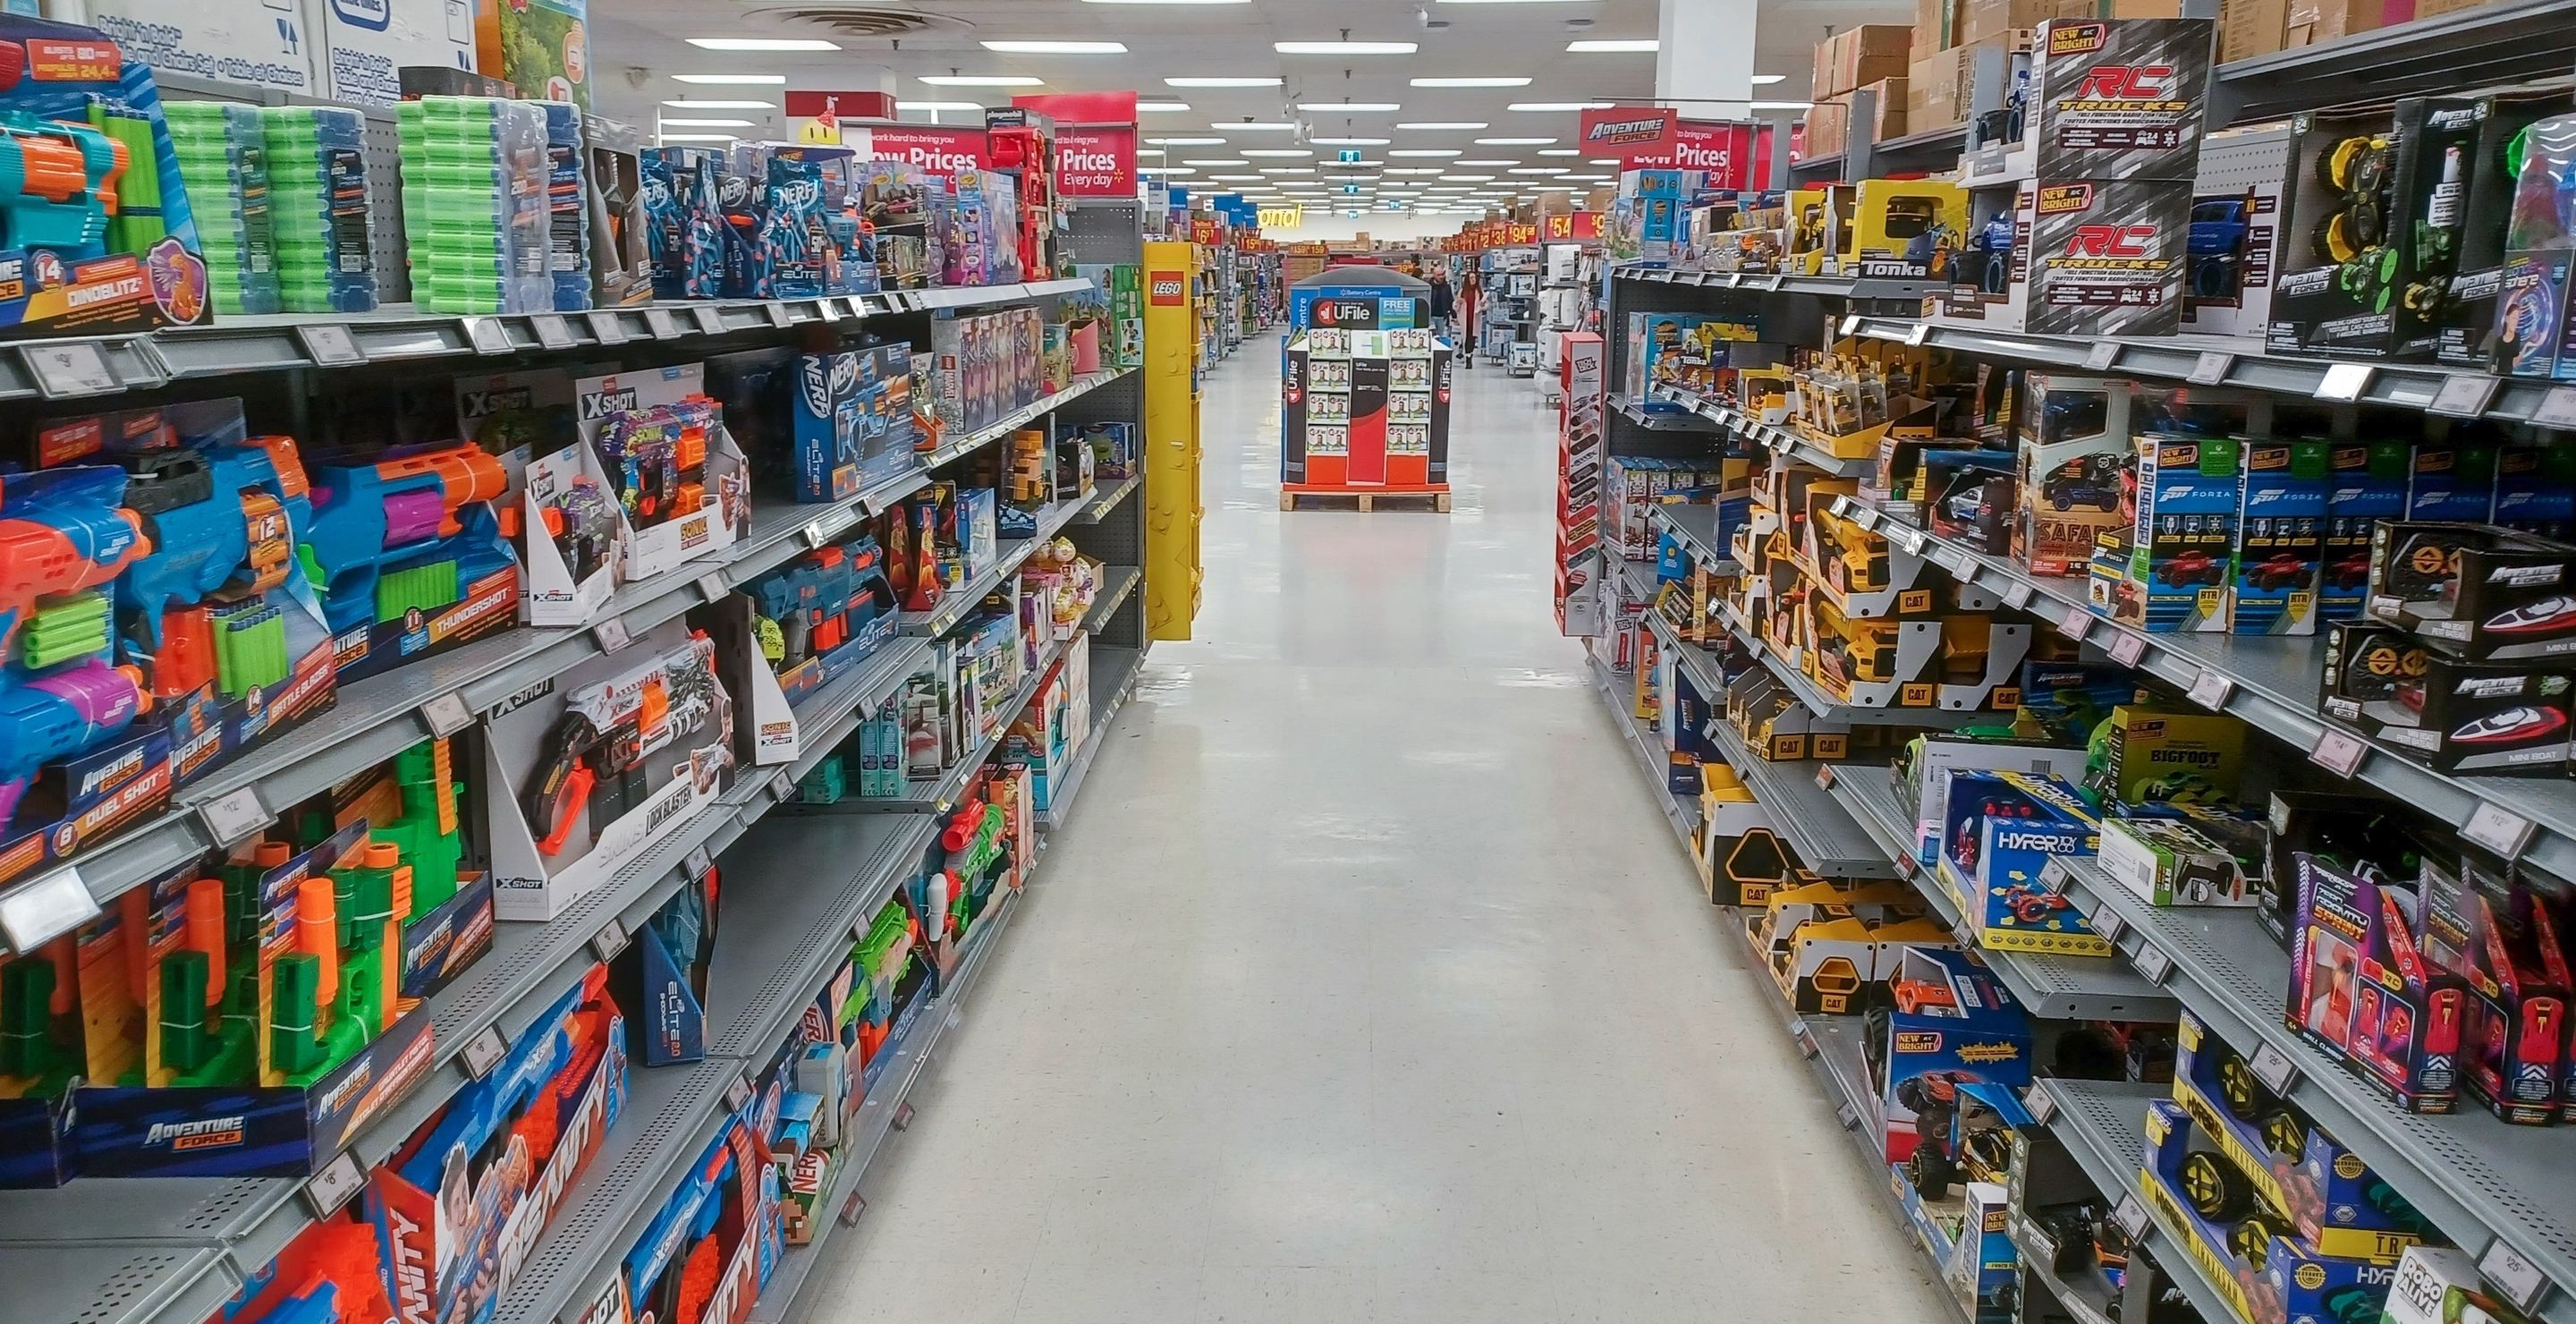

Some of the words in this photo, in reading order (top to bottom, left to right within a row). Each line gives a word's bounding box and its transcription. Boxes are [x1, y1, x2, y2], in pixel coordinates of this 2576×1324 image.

[2054, 29, 2079, 41] NEW
[2054, 37, 2095, 51] BRIGHT
[135, 48, 160, 67] and
[161, 48, 197, 72] Chairs
[197, 54, 216, 75] Set
[225, 58, 253, 79] Table
[254, 64, 266, 81] et
[267, 64, 304, 86] Chaises
[334, 67, 358, 87] Table
[359, 73, 376, 90] and
[2076, 65, 2173, 98] RC
[335, 86, 362, 105] Juego
[362, 90, 376, 106] de
[2057, 99, 2188, 112] TRUCKS
[987, 110, 1023, 120] playmobil
[1588, 118, 1664, 140] ADVENTURE
[1614, 131, 1657, 143] FORCE
[1684, 131, 1699, 140] bring
[1699, 132, 1712, 140] you
[889, 134, 911, 143] hard
[912, 134, 919, 143] to
[919, 134, 937, 145] bring
[938, 136, 954, 145] you
[910, 148, 977, 170] Prices
[1063, 149, 1115, 171] Prices
[1676, 143, 1728, 166] Prices
[1064, 174, 1092, 187] Every
[1094, 174, 1113, 187] day
[718, 180, 748, 207] NERF
[778, 182, 814, 208] NERF
[2043, 189, 2067, 199] NEW
[2042, 197, 2082, 210] BRIGHT
[2064, 225, 2157, 257] RC
[38, 259, 61, 283] 14
[1860, 260, 1927, 277] Tonka
[2046, 258, 2170, 269] TRUCKS
[2275, 268, 2331, 292] ADVENTURE
[2293, 282, 2326, 293] FORCE
[2449, 268, 2504, 294] ADVENTURE
[67, 278, 140, 308] DINOBLITZ
[1153, 281, 1182, 297] LEGO
[2465, 283, 2496, 297] FORCE
[1334, 305, 1370, 320] UFile
[1383, 300, 1411, 309] FREE
[1576, 356, 1594, 368] TECH
[1578, 361, 1597, 373] DECK
[1681, 355, 1707, 366] Tonka
[830, 360, 855, 391] NERF
[1288, 360, 1298, 390] UFile
[1442, 360, 1452, 390] UFile
[802, 355, 830, 418] NERF
[945, 370, 955, 400] MARVEL
[2161, 454, 2191, 466] BRIGHT
[2162, 449, 2180, 457] NEW
[2192, 490, 2231, 498] FORZA
[2284, 493, 2322, 501] FORZA
[259, 516, 275, 540] 12
[680, 517, 708, 541] SONIC
[1904, 595, 1925, 607] CAT
[2201, 590, 2217, 599] RTR
[2291, 594, 2308, 602] RTR
[436, 589, 508, 633] THUNDERSHOT
[2452, 624, 2466, 632] BOAT
[2546, 642, 2568, 652] MINI
[2454, 675, 2528, 695] ADVENTURE
[2478, 684, 2522, 696] FORCE
[272, 686, 301, 718] BATTLE
[1907, 688, 1928, 700] CAT
[1997, 692, 2018, 705] CAT
[761, 722, 792, 732] SONIC
[2419, 731, 2434, 742] BOAT
[1779, 740, 1800, 753] CAT
[1818, 739, 1839, 752] CAT
[182, 741, 217, 775] FORCE
[2150, 750, 2221, 765] BIGFOOT
[2509, 753, 2529, 762] MINI
[2530, 751, 2557, 760] BOAT
[80, 745, 145, 796] ADVENTURE
[102, 760, 140, 791] FORCE
[86, 798, 121, 828] DUEL
[123, 771, 158, 805] SHOT
[647, 804, 665, 836] LOCK
[665, 784, 692, 818] BLASTER
[60, 825, 72, 847] 8
[1998, 832, 2059, 853] HYPER
[1746, 887, 1767, 901] CAT
[2314, 907, 2367, 940] SPRINT
[2428, 913, 2469, 946] SPRINT
[404, 914, 453, 975] ADVENTURE
[2385, 973, 2400, 988] RC
[668, 981, 681, 1042] ELITE
[1826, 997, 1843, 1009] CAT
[1898, 1035, 1919, 1043] NEW
[1898, 1041, 1934, 1052] BRIGHT
[2302, 1031, 2318, 1047] WALL
[670, 1040, 682, 1058] 2.0
[318, 1057, 371, 1120] ADVENTURE
[335, 1073, 369, 1110] FORCE
[144, 1116, 244, 1145] ADVENTURE
[178, 1131, 238, 1150] FORCE
[2021, 1219, 2055, 1253] ADVENTURE
[2402, 1256, 2443, 1301] ROBO
[2397, 1277, 2436, 1318] ALIVE
